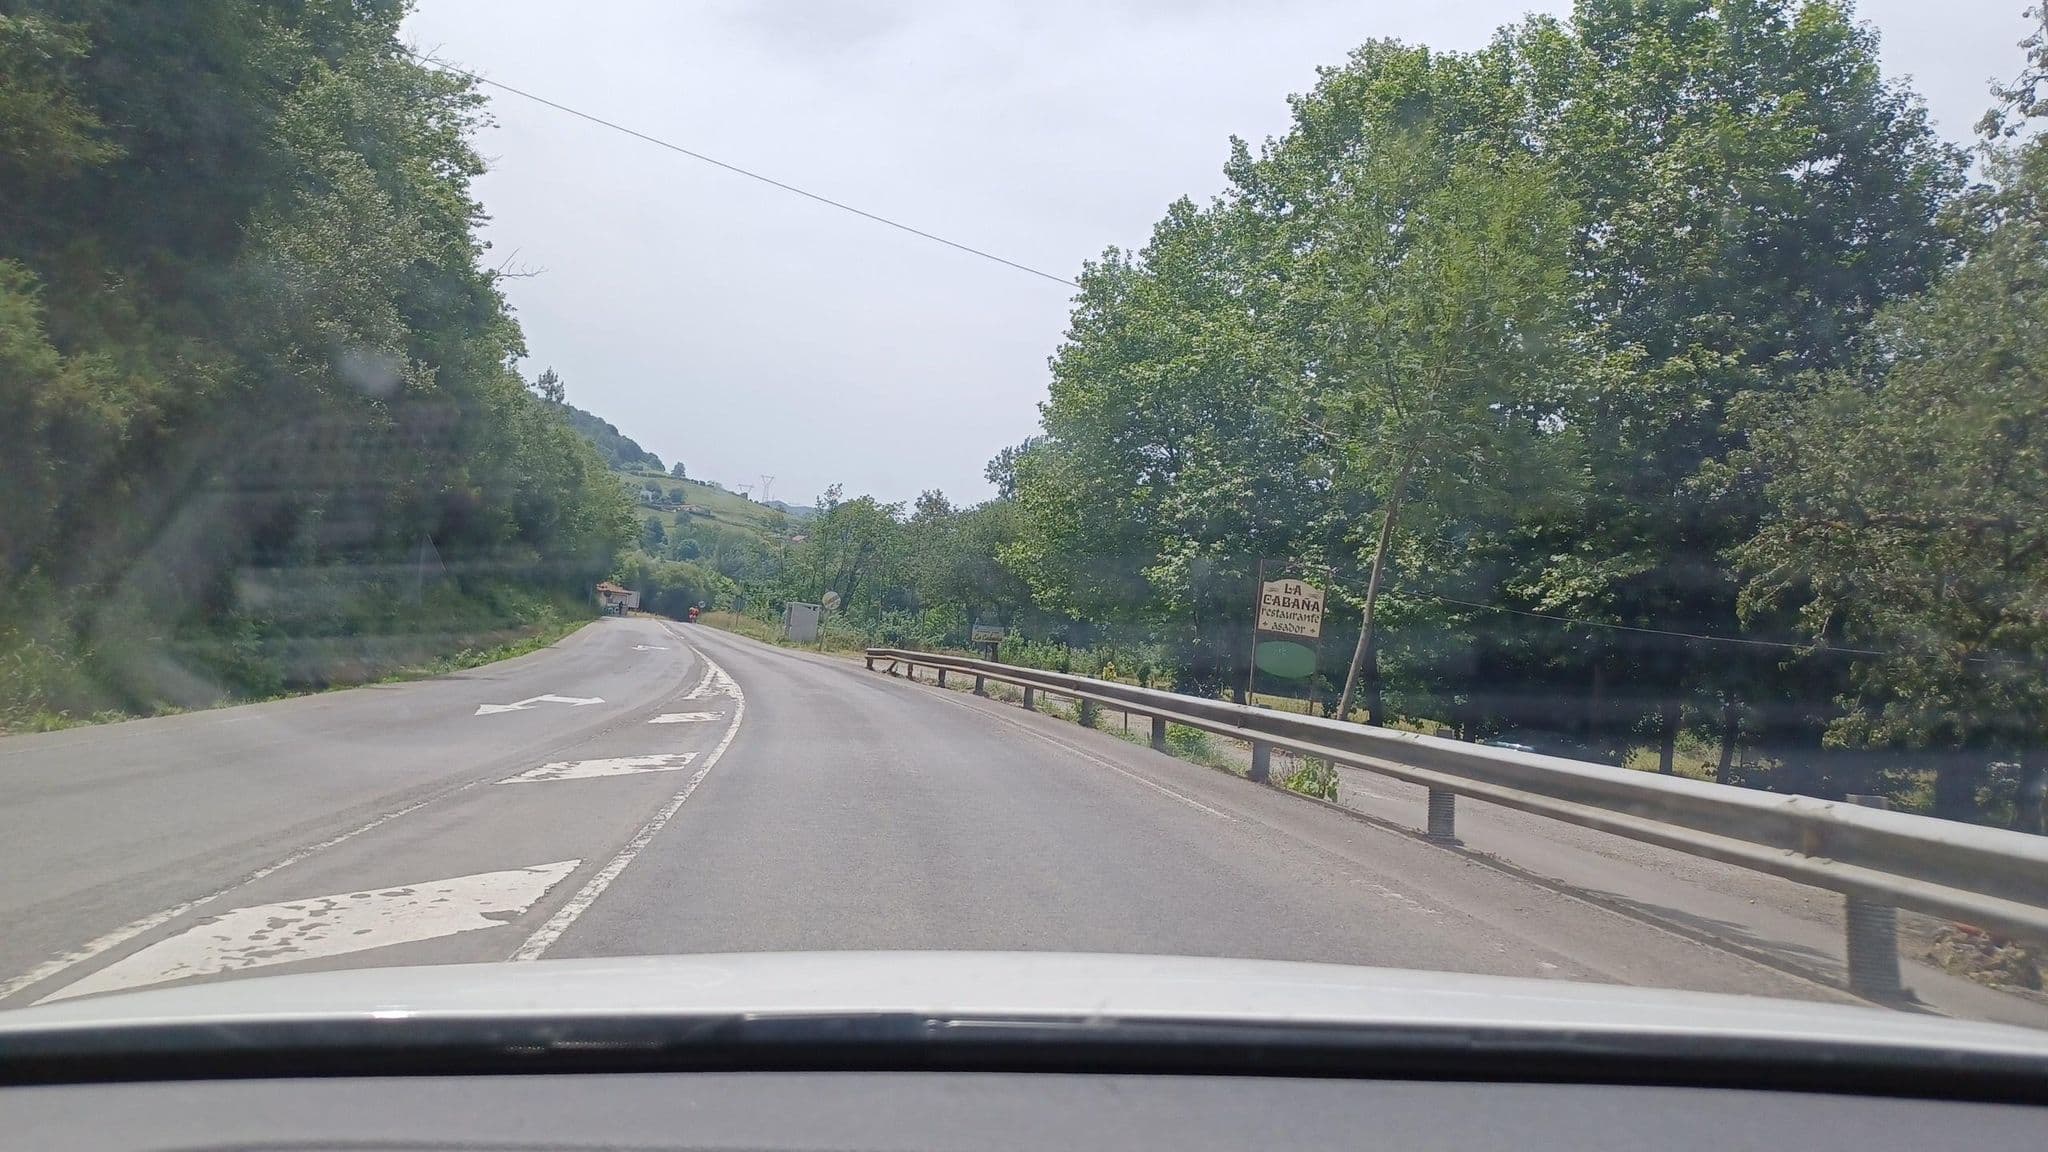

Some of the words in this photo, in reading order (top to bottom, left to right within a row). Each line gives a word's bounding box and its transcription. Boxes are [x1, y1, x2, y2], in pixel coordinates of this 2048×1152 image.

[1284, 583, 1302, 596] LA
[1263, 594, 1320, 612] CABAÑA
[1261, 607, 1320, 624] restaurante
